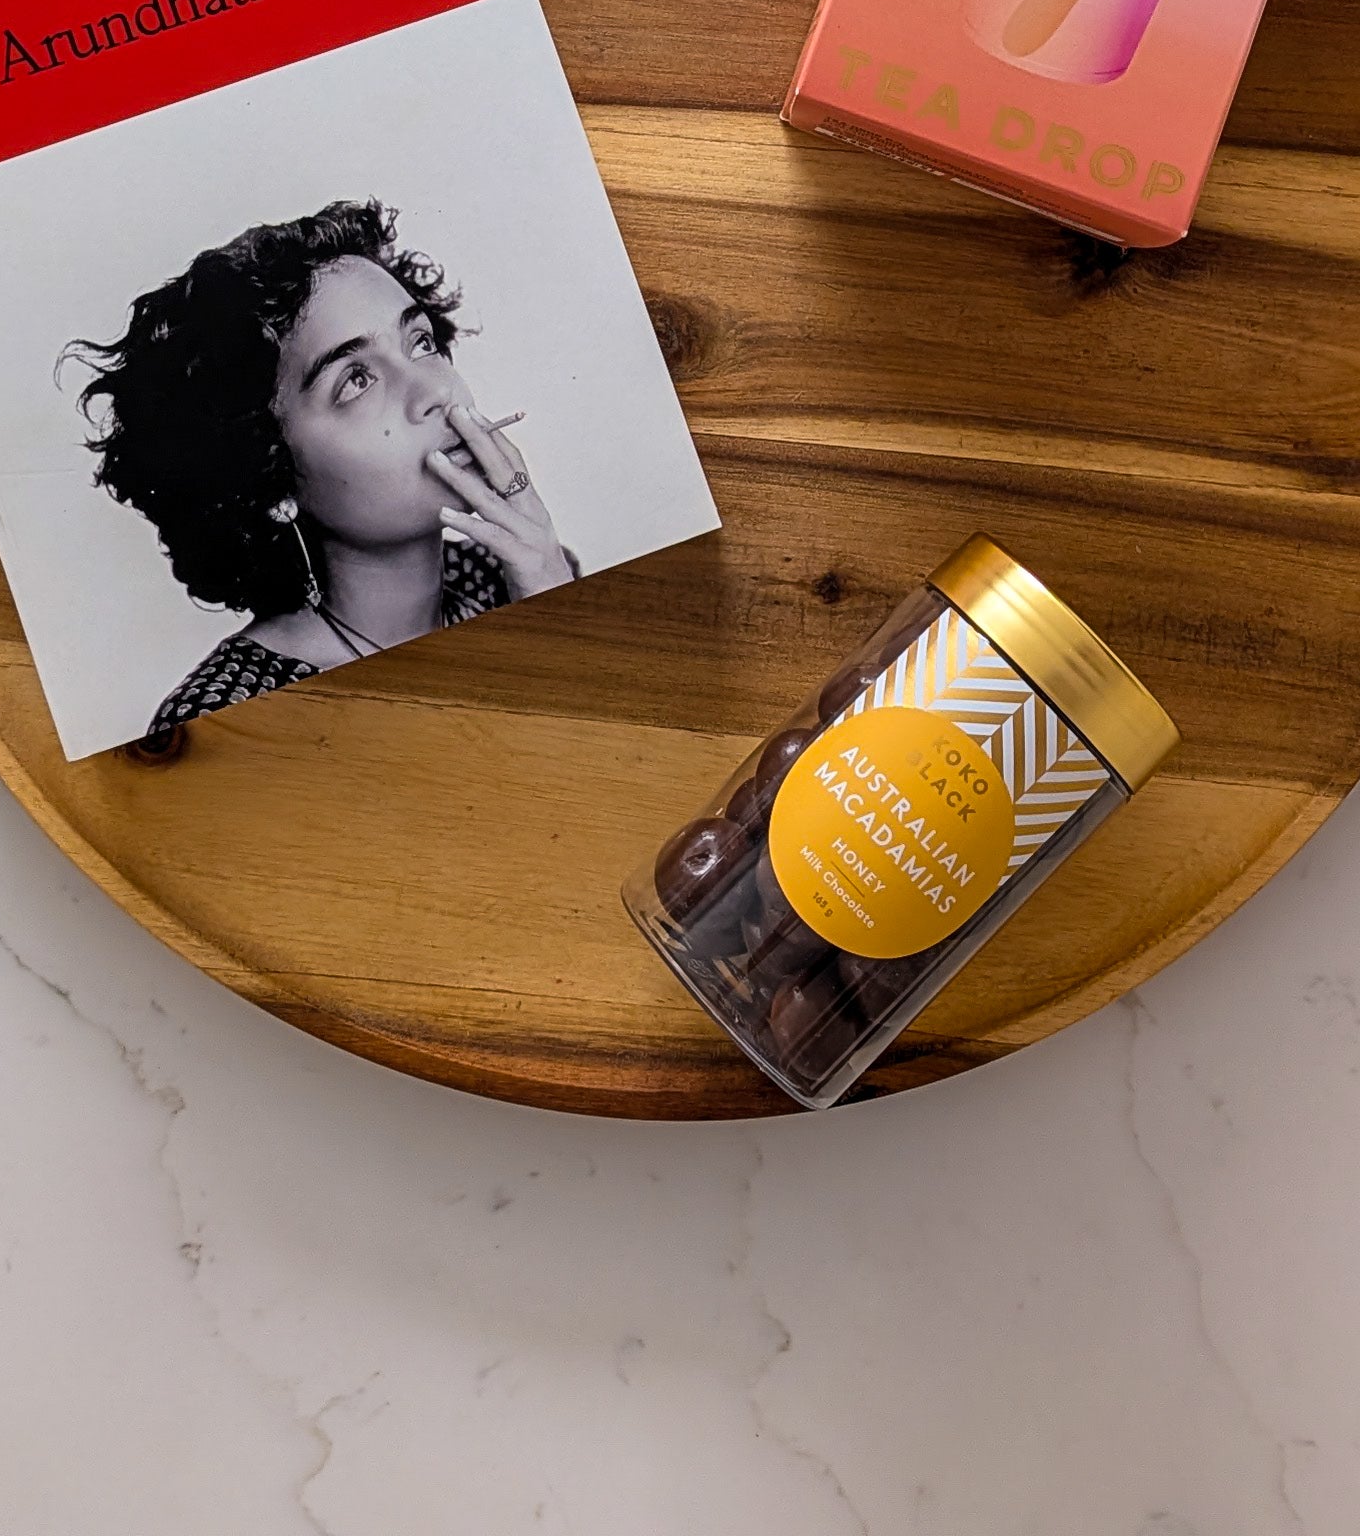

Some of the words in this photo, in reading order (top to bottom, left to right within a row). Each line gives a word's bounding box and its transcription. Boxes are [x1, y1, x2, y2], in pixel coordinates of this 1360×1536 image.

[837, 44, 963, 132] TEA
[988, 104, 1187, 202] DROP
[840, 746, 976, 888] AUSTRALIAN
[932, 736, 989, 795] KOKO
[800, 845, 823, 873] Milk
[823, 871, 875, 929] Chocolate
[814, 761, 957, 914] MACADAMIAS
[831, 837, 886, 893] HONEY
